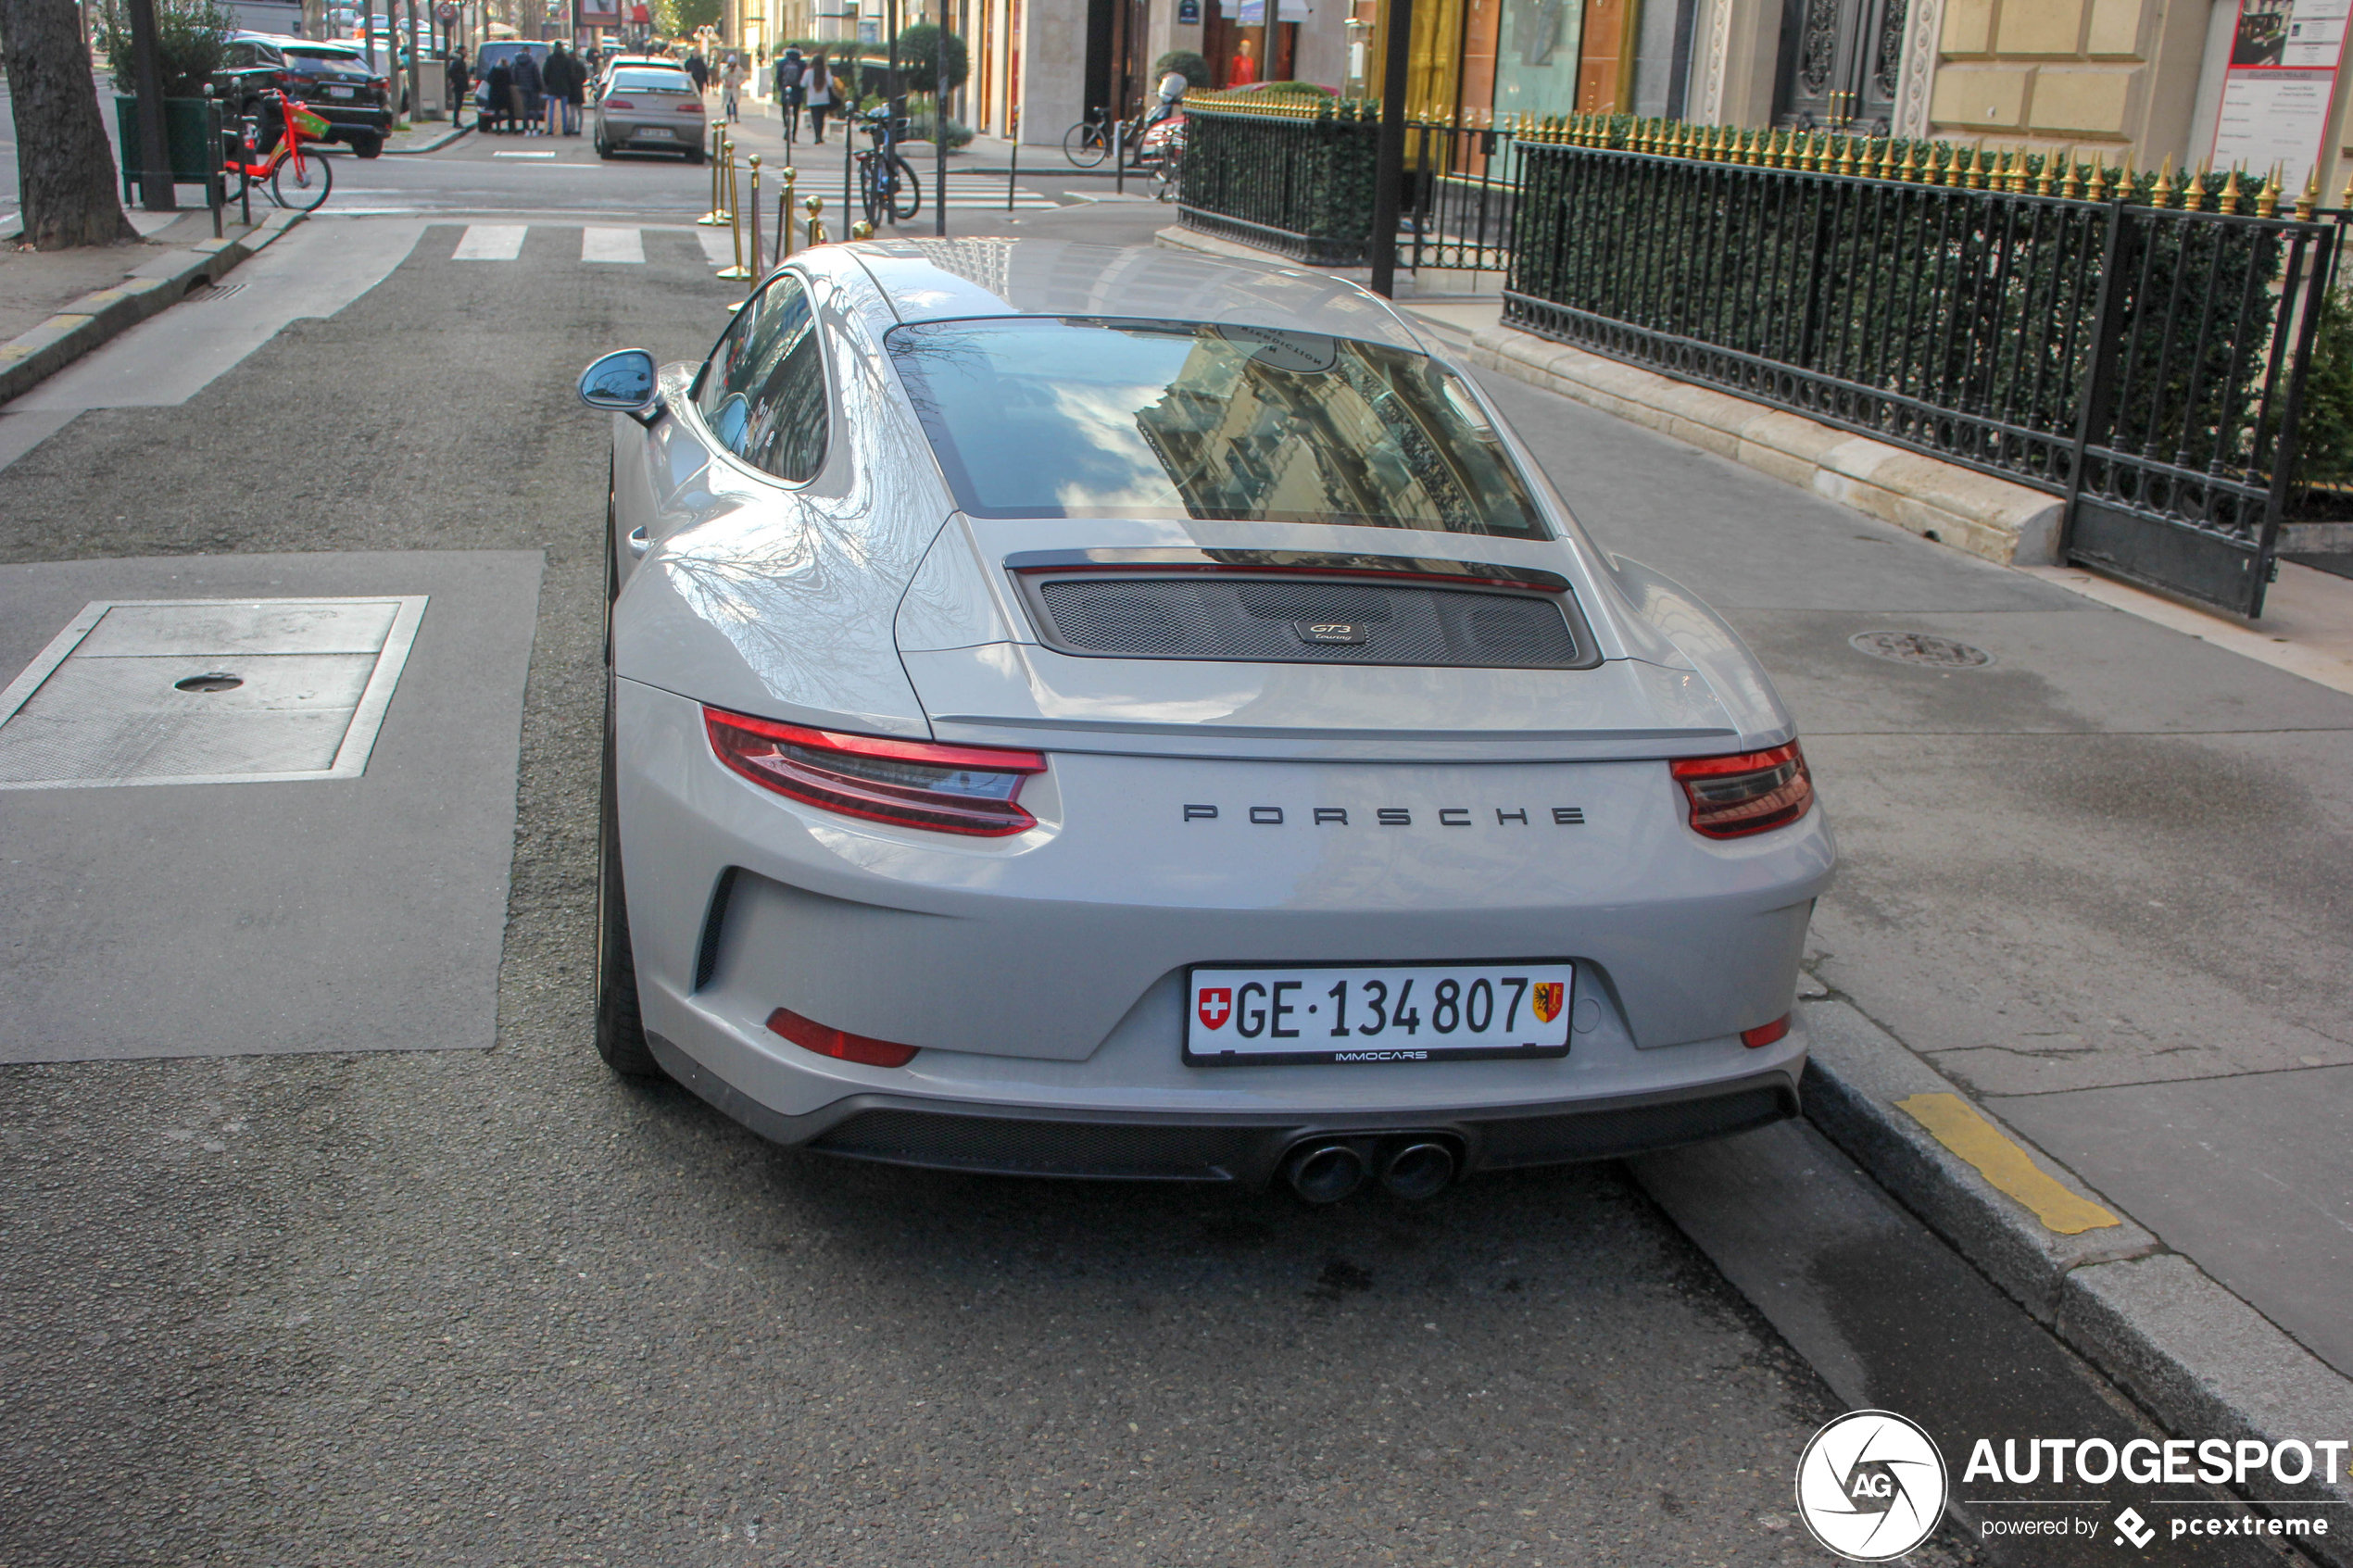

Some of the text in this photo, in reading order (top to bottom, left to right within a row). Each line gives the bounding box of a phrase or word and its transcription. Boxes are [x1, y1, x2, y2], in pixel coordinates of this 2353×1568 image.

[1310, 624, 1352, 633] GT3
[1183, 804, 1585, 825] PORSCHE
[1335, 1050, 1428, 1061] IMMOCARS
